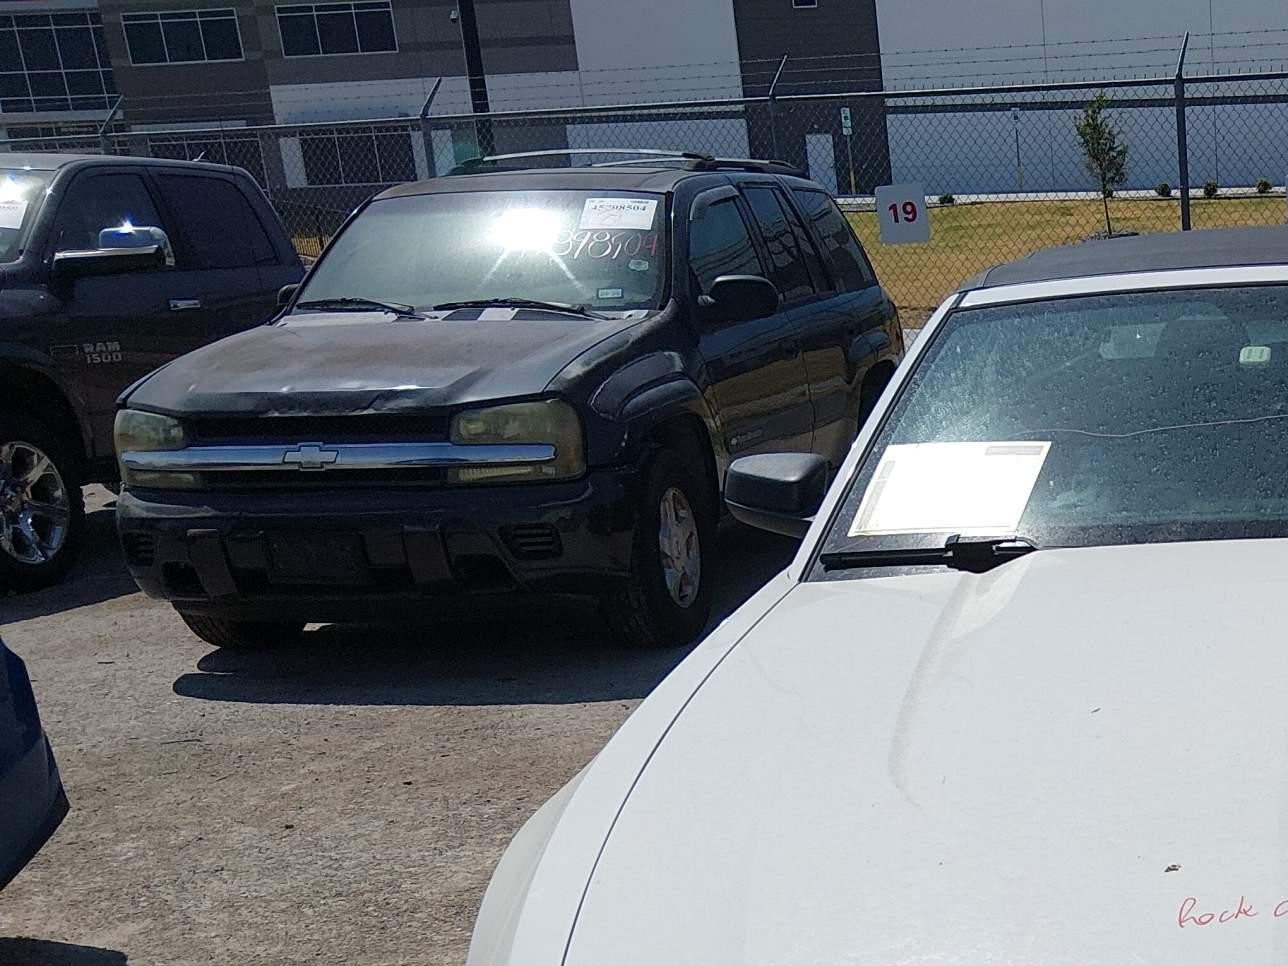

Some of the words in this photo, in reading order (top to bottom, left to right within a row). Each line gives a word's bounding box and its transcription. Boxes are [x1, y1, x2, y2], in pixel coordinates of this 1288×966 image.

[888, 201, 918, 223] 19
[83, 341, 120, 353] RAM
[85, 352, 122, 363] 1500
[1178, 895, 1259, 928] Rock
